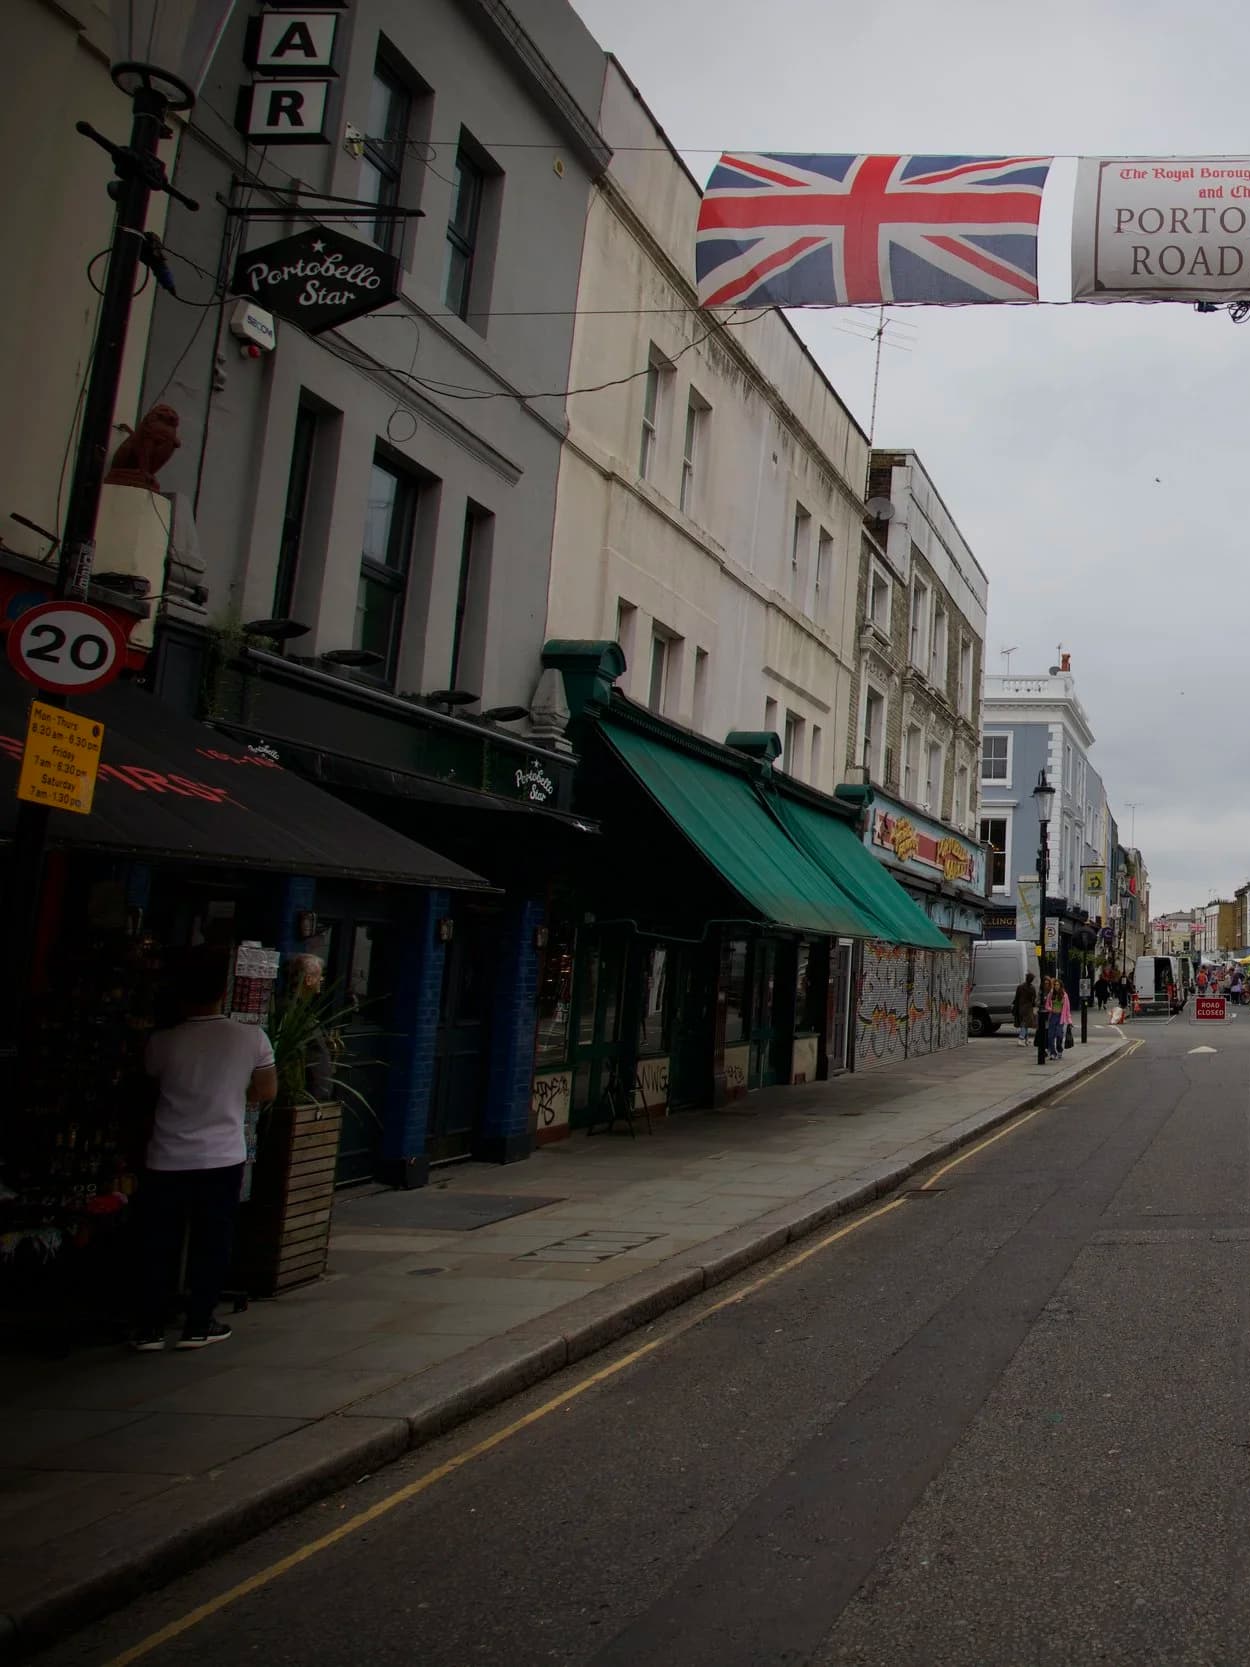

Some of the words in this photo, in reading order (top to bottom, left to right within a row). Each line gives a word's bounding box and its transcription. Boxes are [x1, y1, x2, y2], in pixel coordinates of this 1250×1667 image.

[1119, 167, 1147, 180] The
[1151, 167, 1195, 182] Royal
[1199, 186, 1224, 199] and
[247, 253, 381, 292] Portobello
[298, 279, 357, 306] Star
[27, 624, 109, 671] 20
[52, 745, 75, 761] Friday
[41, 774, 76, 792] Saturday
[514, 769, 553, 795] Portobello
[529, 783, 547, 802] Star
[1197, 1009, 1225, 1017] CLOSED
